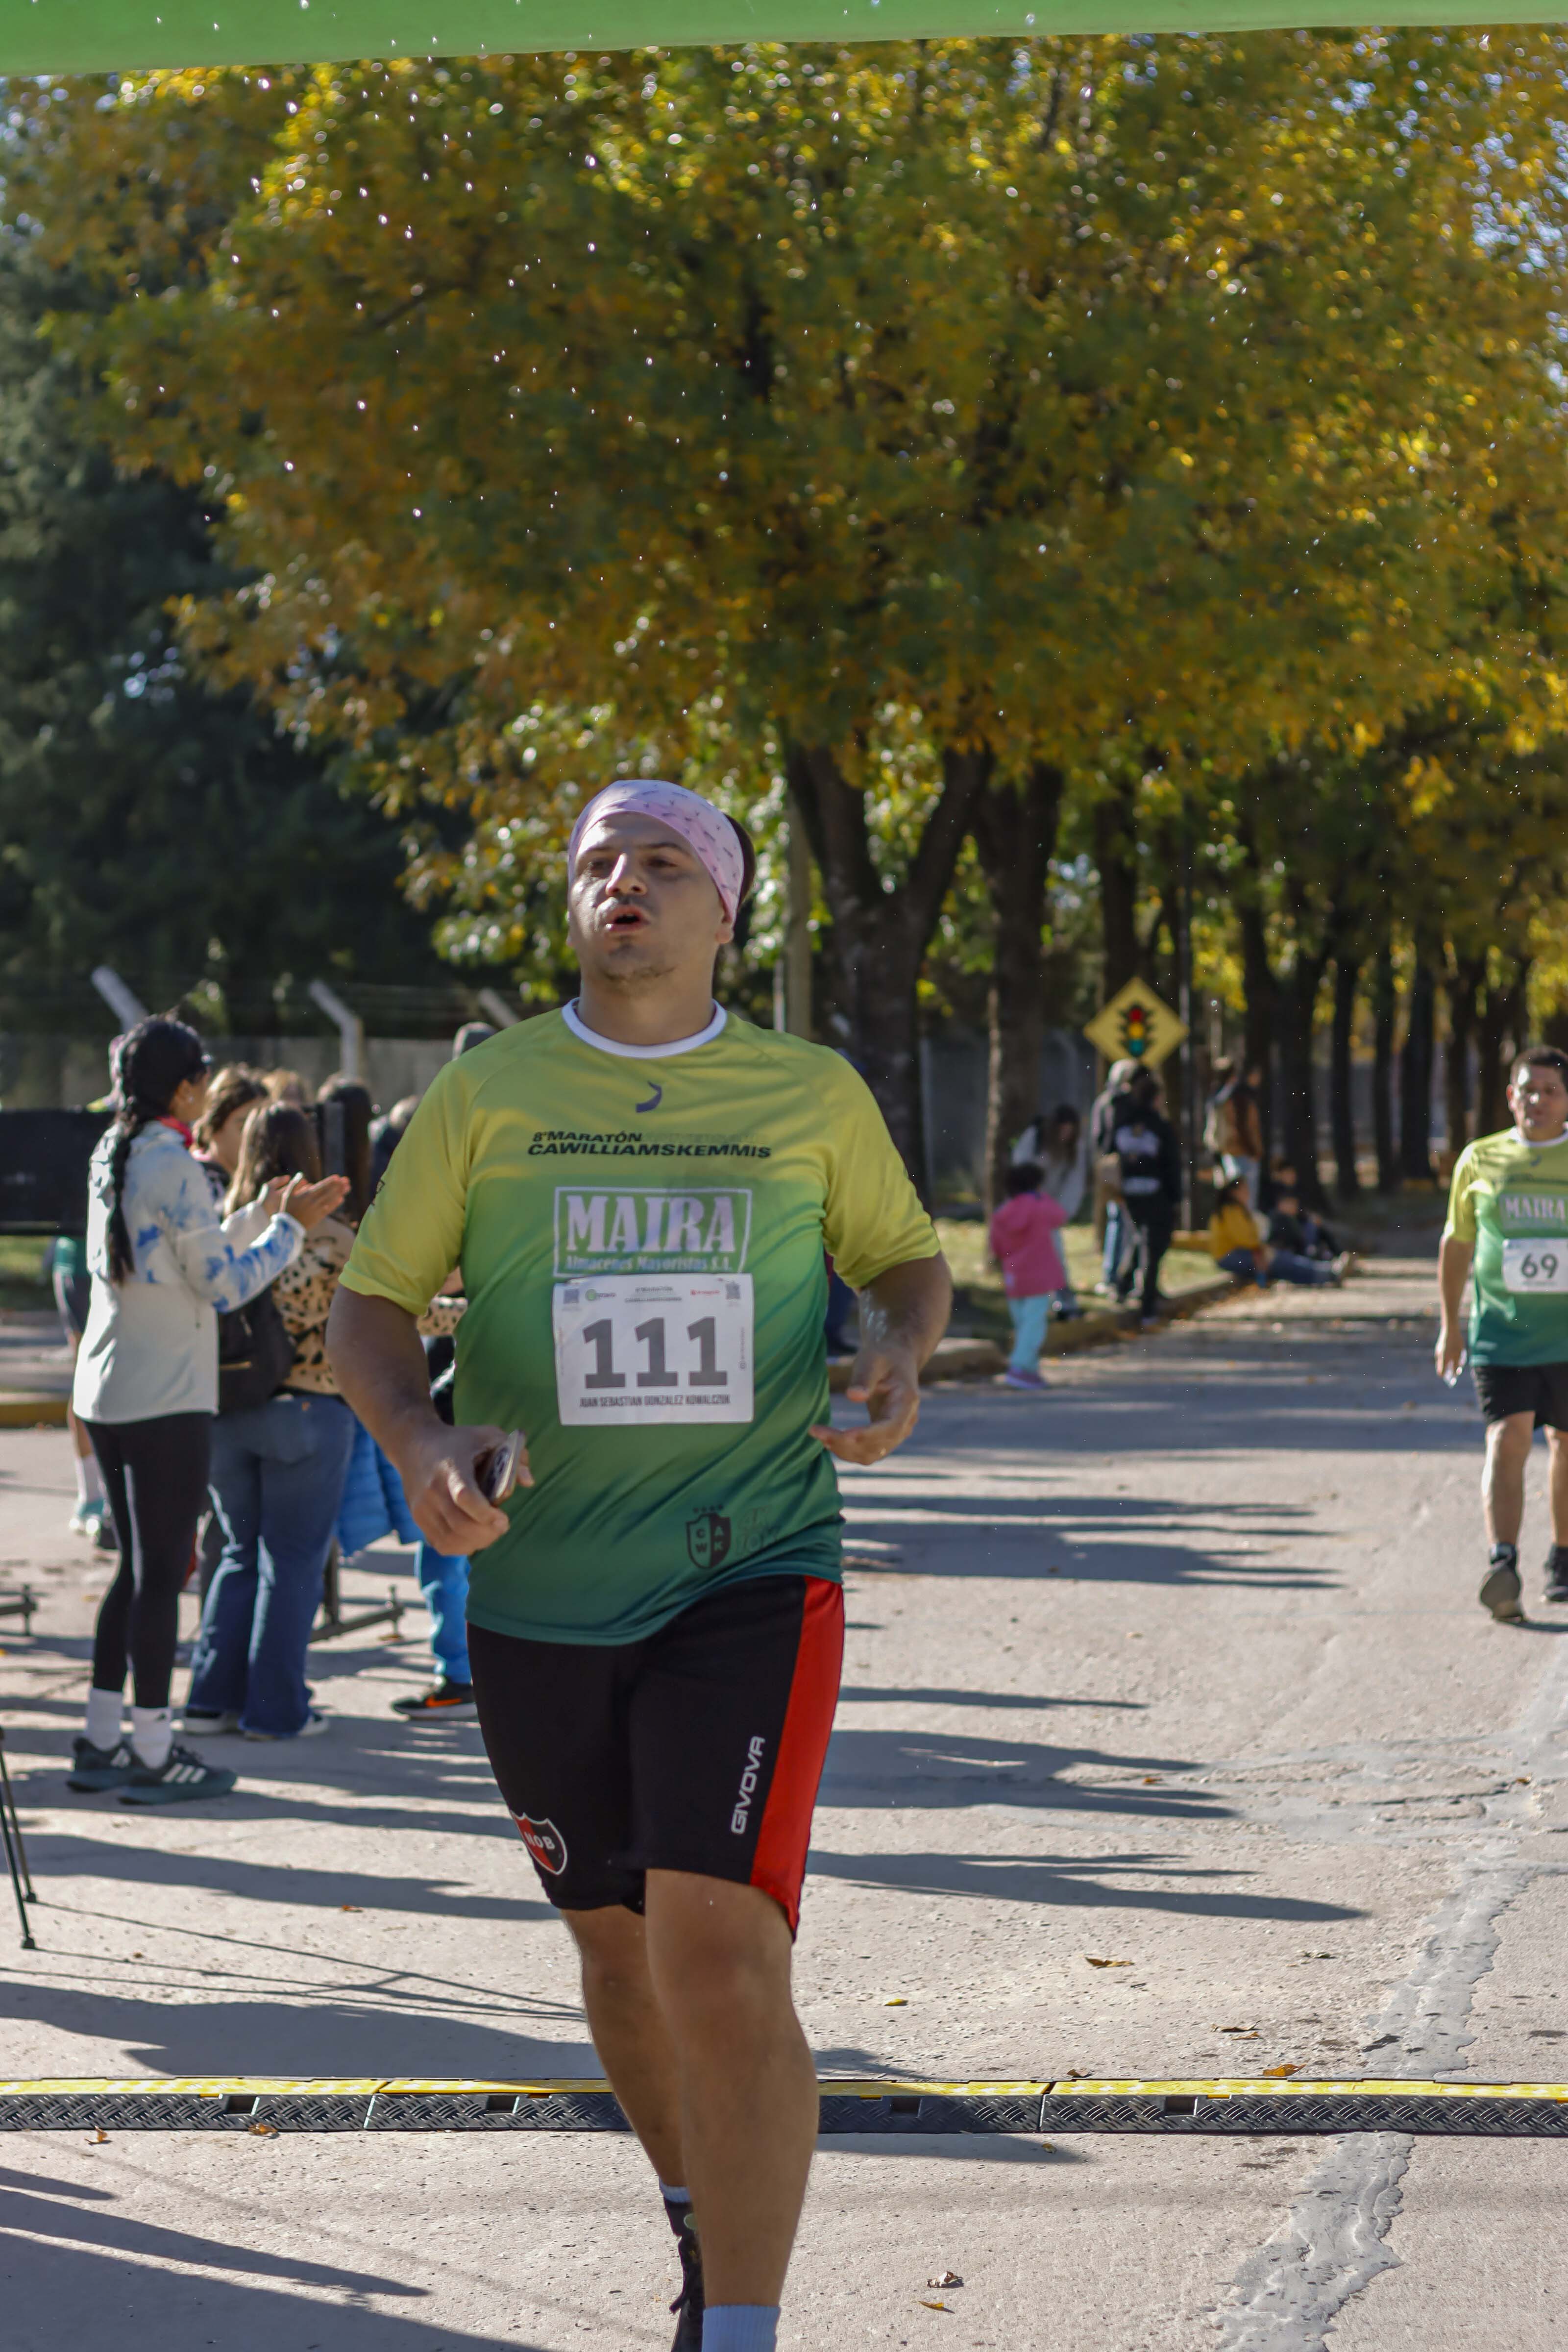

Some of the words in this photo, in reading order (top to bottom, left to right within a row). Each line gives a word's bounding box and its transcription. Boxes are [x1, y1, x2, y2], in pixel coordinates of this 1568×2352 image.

[565, 1195, 736, 1252] MAIRA
[1521, 1252, 1559, 1278] 69
[582, 1316, 728, 1389] 111
[730, 1735, 766, 1835] GIVOVA
